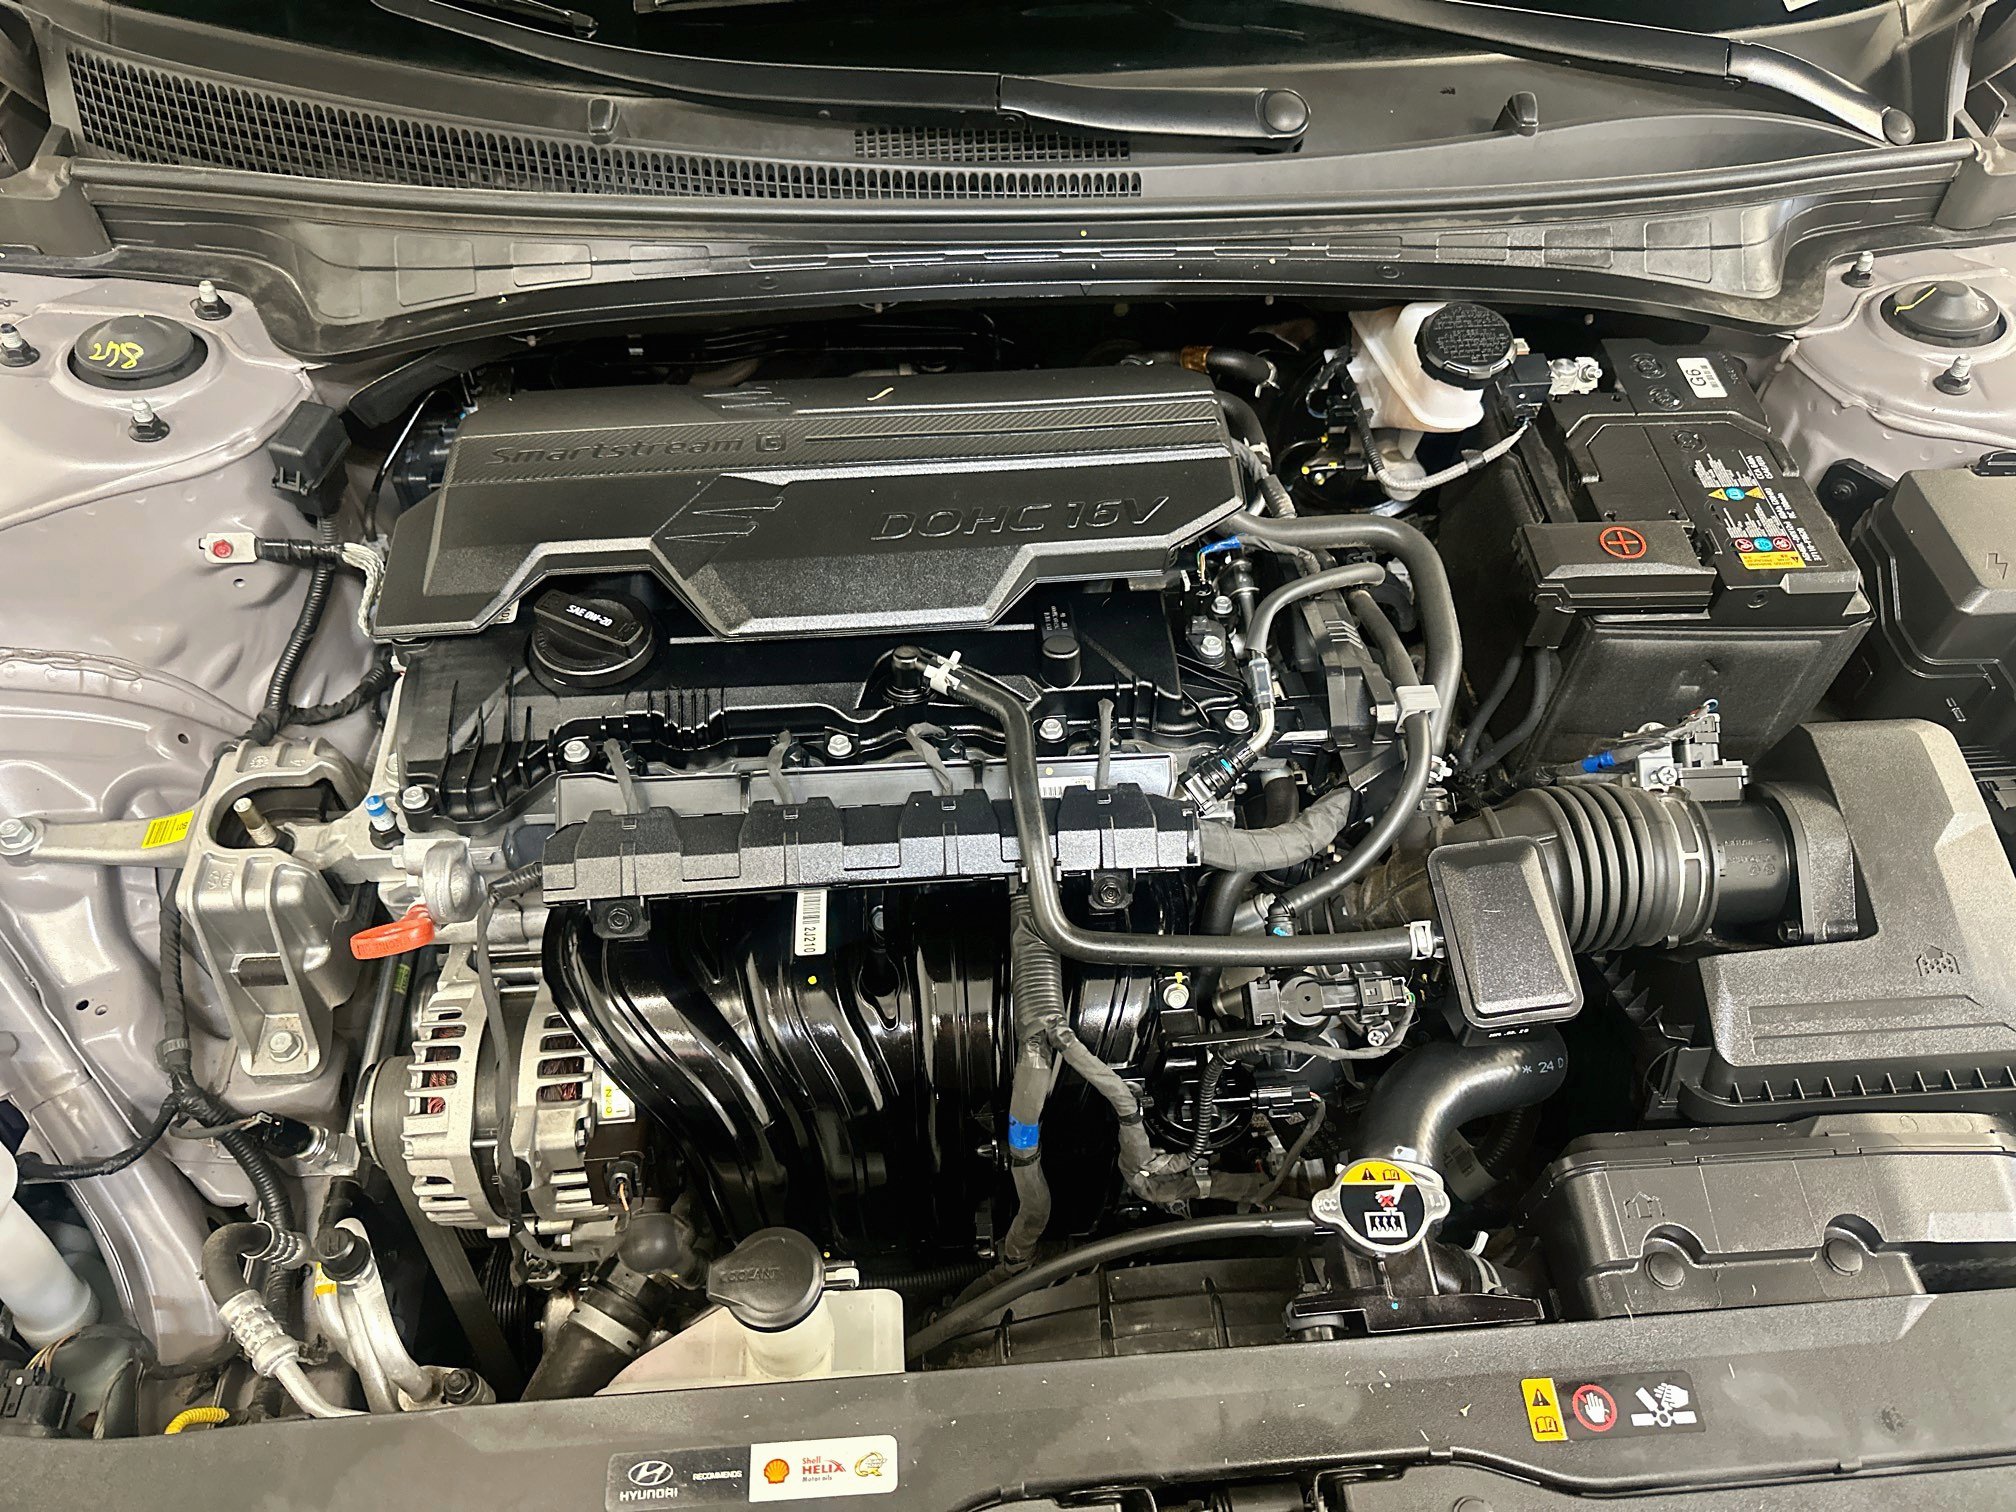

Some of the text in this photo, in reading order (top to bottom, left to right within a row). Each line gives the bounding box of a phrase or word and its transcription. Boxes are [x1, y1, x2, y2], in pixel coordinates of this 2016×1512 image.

[1686, 369, 1707, 386] G6
[485, 440, 743, 465] Smartstream
[870, 496, 1169, 541] DOHC 16V
[565, 604, 613, 627] SAE 0W-20
[803, 926, 817, 953] 2J210
[1538, 1060, 1555, 1073] 24
[720, 1266, 780, 1282] COOLANT
[802, 1456, 821, 1465] Shell
[802, 1460, 846, 1475] HELIX
[692, 1470, 743, 1481] RECOMMENDS
[619, 1487, 679, 1501] HYUNDAI
